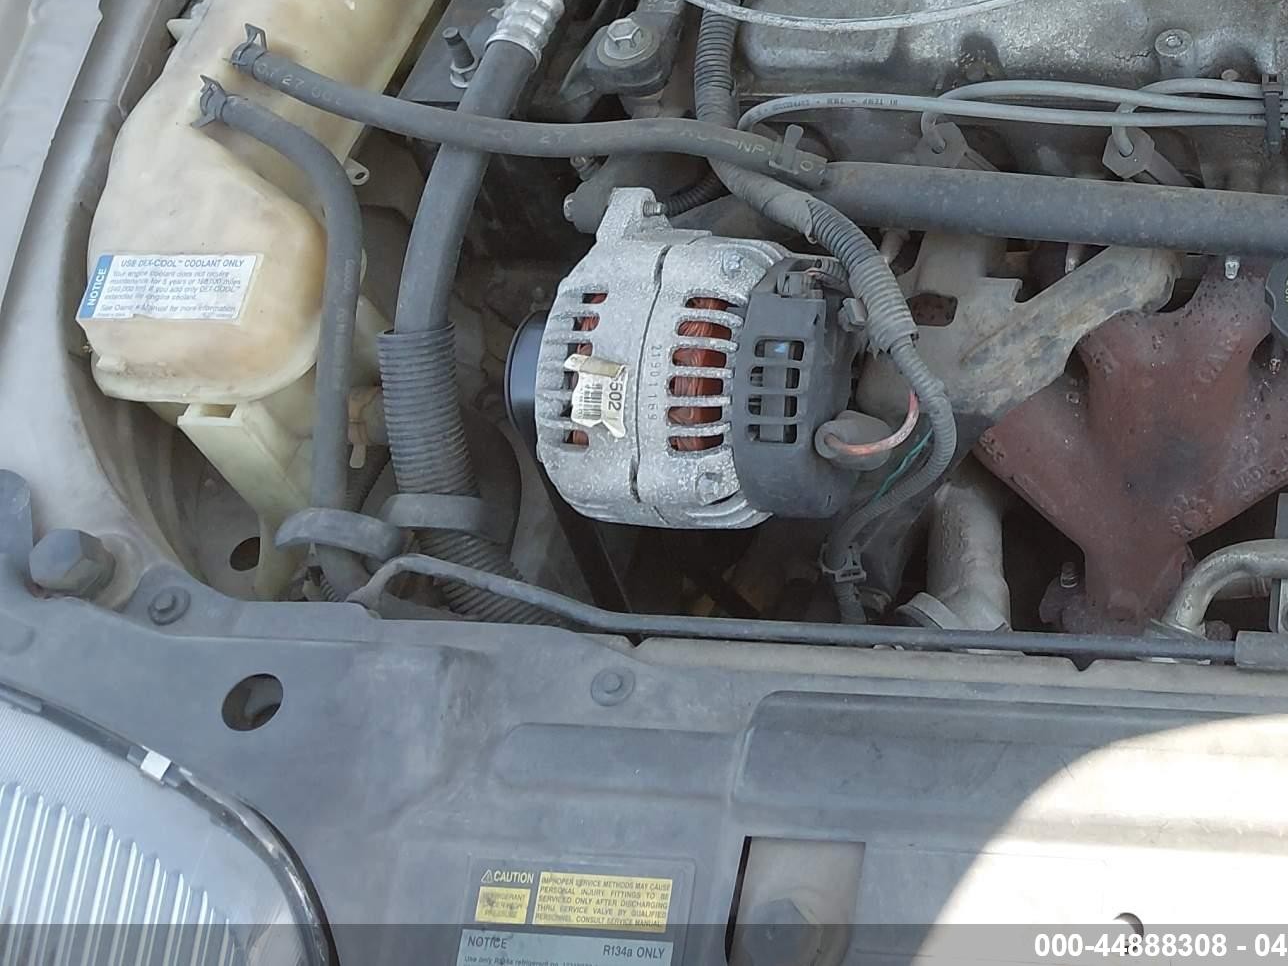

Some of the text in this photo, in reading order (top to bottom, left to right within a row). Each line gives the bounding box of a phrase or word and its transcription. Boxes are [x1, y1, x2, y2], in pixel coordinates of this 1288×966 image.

[184, 259, 221, 268] COOLANT
[222, 259, 245, 268] ONLY
[87, 267, 107, 306] NOTICE
[493, 870, 534, 884] CAUTION
[540, 886, 575, 895] PERSONAL
[611, 891, 641, 899] FITTINGS
[636, 882, 649, 890] MAY
[575, 897, 593, 905] ONLY
[621, 900, 668, 910] DISCHARGING
[537, 904, 556, 912] THRU
[593, 907, 612, 915] VALVE
[631, 910, 666, 919] QUALIFIED
[576, 916, 605, 924] CONSULT
[467, 936, 665, 959] NOTICE R134a ONLY
